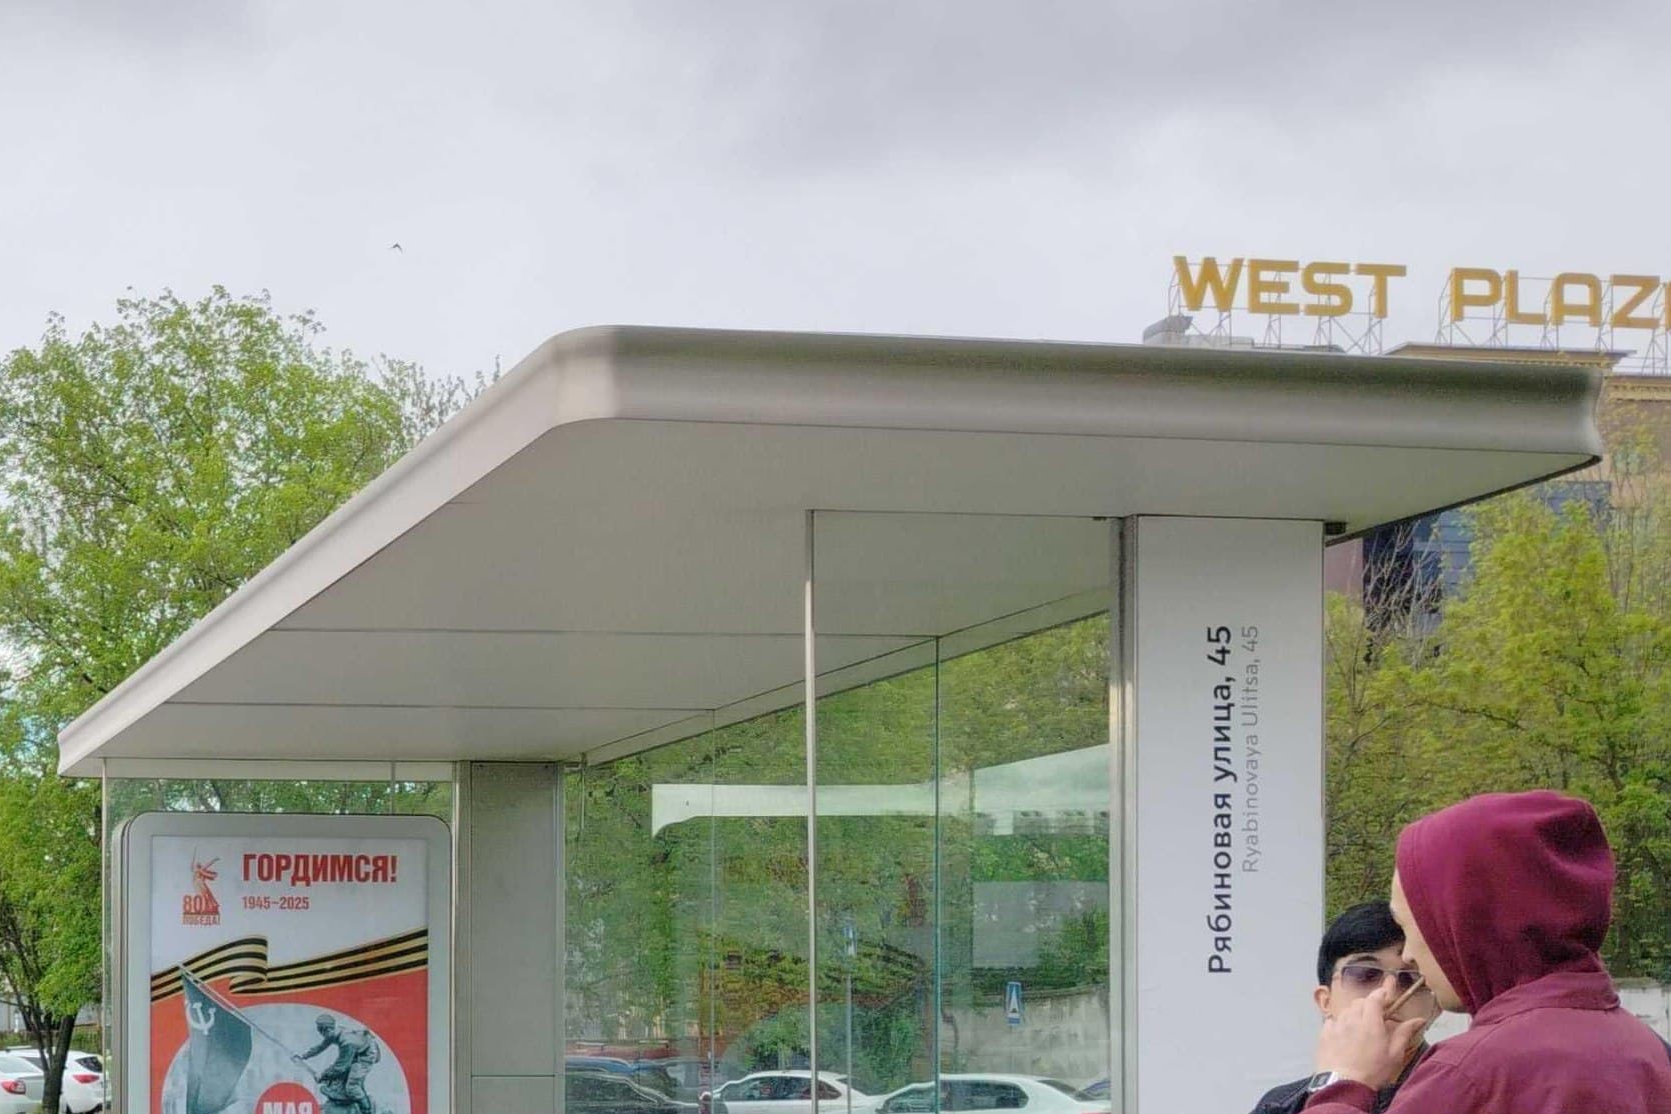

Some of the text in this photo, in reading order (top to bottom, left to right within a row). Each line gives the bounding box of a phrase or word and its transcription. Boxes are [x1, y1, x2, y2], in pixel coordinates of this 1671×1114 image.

[1173, 256, 1671, 331] WEST PLAZ
[1207, 625, 1237, 974] Рябиновая улица, 45
[1241, 625, 1261, 873] Ryabinovaya Ulitsa, 45
[242, 853, 398, 887] ГОРДИМСЯ!
